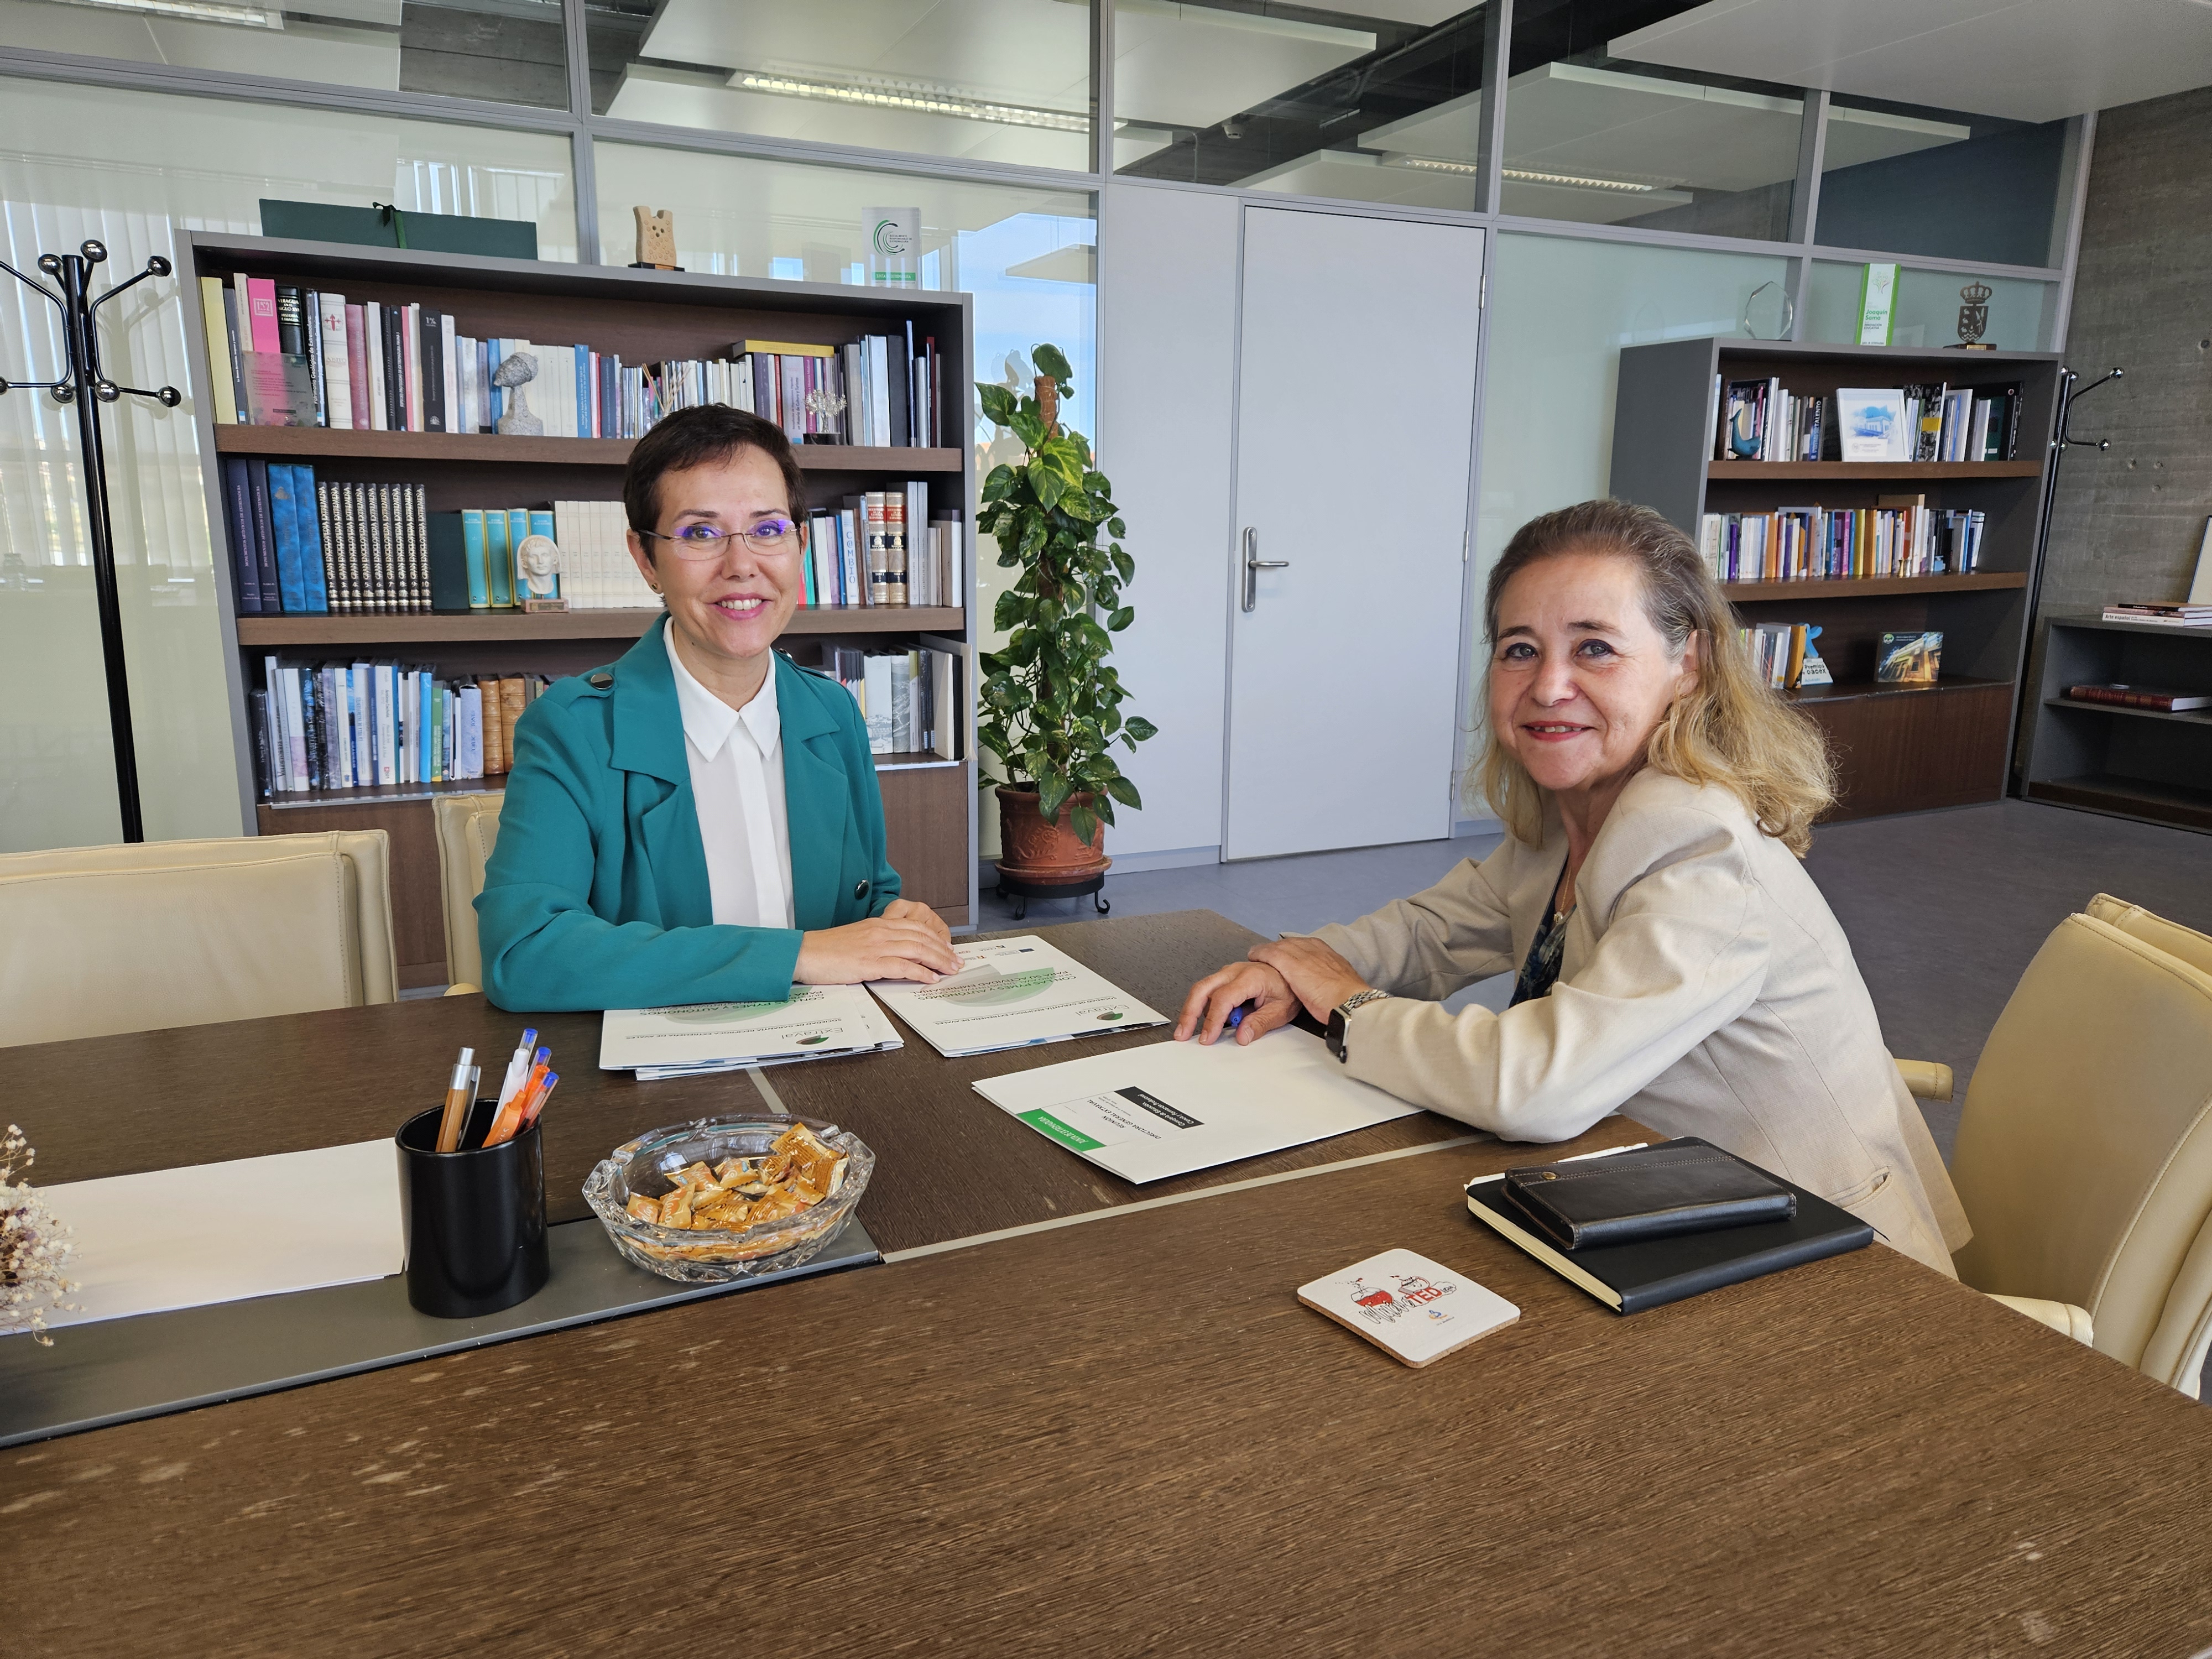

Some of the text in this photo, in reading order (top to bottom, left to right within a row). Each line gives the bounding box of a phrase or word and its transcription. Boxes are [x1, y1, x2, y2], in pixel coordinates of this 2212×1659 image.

[318, 486, 334, 580] GRAN ENCICLOPEDIA EXTREMEÑA
[331, 487, 347, 580] GRAN ENCICLOPEDIA EXTREMEÑA
[343, 487, 359, 580] GRAN ENCICLOPEDIA EXTREMEÑA
[356, 487, 371, 580] GRAN ENCICLOPEDIA EXTREMEÑA
[368, 487, 383, 580] GRAN ENCICLOPEDIA EXTREMEÑA
[380, 488, 395, 580] GRAN ENCICLOPEDIA EXTREMEÑA
[392, 487, 407, 580] GRAN ENCICLOPEDIA EXTREMEÑA
[404, 487, 418, 580] GRAN ENCICLOPEDIA EXTREMEÑA
[416, 488, 430, 580] GRAN ENCICLOPEDIA EXTREMEÑA
[242, 539, 250, 567] MONUMENTOS
[261, 540, 269, 567] MONUMENTOS
[910, 983, 977, 995] EMPRESARIAL
[977, 975, 1027, 988] ACTIVIDAD
[997, 982, 1032, 991] PYMES
[917, 989, 987, 1001] AUTÓNOMOS
[640, 1006, 719, 1016] AUTÓNOMOS
[732, 1001, 772, 1010] PYMES
[1010, 1007, 1046, 1016] RECÍPROCA
[1074, 1004, 1130, 1017] Extraval
[755, 1025, 794, 1033] GARANTÍA
[781, 1027, 843, 1040] Extraval
[1086, 1099, 1112, 1115] EXTRAVAL
[1037, 1115, 1068, 1135] EXTREMADURA
[1101, 1115, 1126, 1129] REUNIÓN
[1110, 1112, 1134, 1126] GENERAL
[1072, 1133, 1089, 1144] JUNTA
[1131, 1124, 1162, 1140] DIRECTORA
[1405, 1287, 1443, 1305] TED
